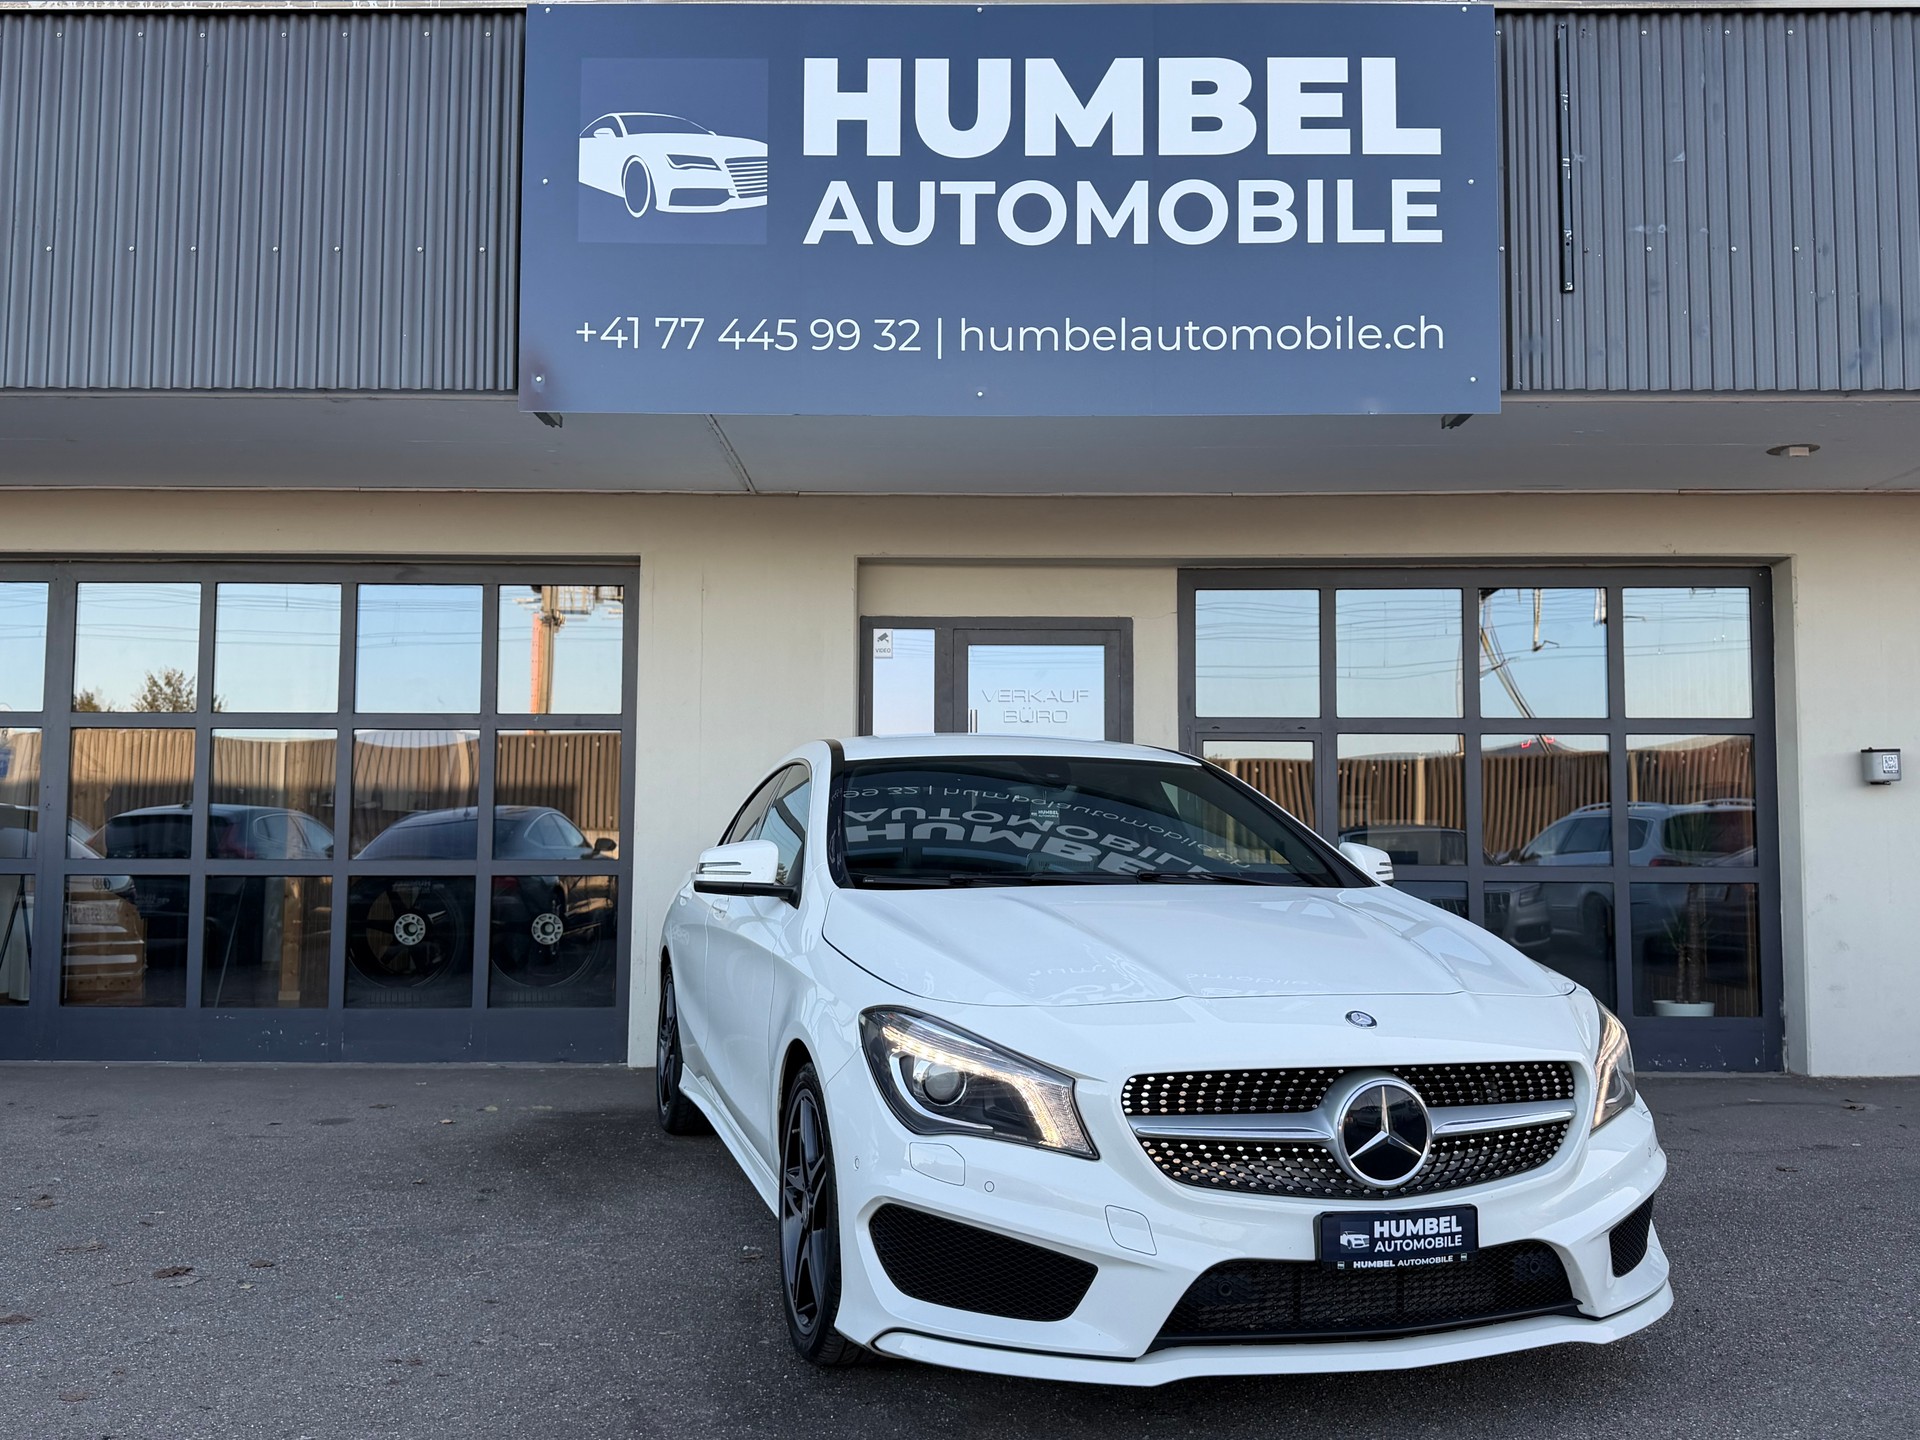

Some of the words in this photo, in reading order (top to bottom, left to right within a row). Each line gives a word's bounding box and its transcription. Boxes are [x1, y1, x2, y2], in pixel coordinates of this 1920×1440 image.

[803, 57, 1442, 159] HUMBEL
[803, 179, 1443, 246] AUTOMOBILE
[575, 317, 639, 349] +41
[655, 318, 705, 350] 77
[717, 318, 798, 351] 445
[809, 318, 861, 351] 99
[873, 318, 922, 352] 32
[960, 315, 1444, 352] humbelautomobile.ch
[981, 689, 1090, 703] VERKAUF
[1003, 707, 1069, 723] BÜRO
[1374, 1215, 1462, 1239] HUMBEL
[1374, 1234, 1462, 1253] AUTOMOBILE
[1353, 1260, 1396, 1269] HUMBEL
[1397, 1255, 1454, 1267] AUTOMOBILE
